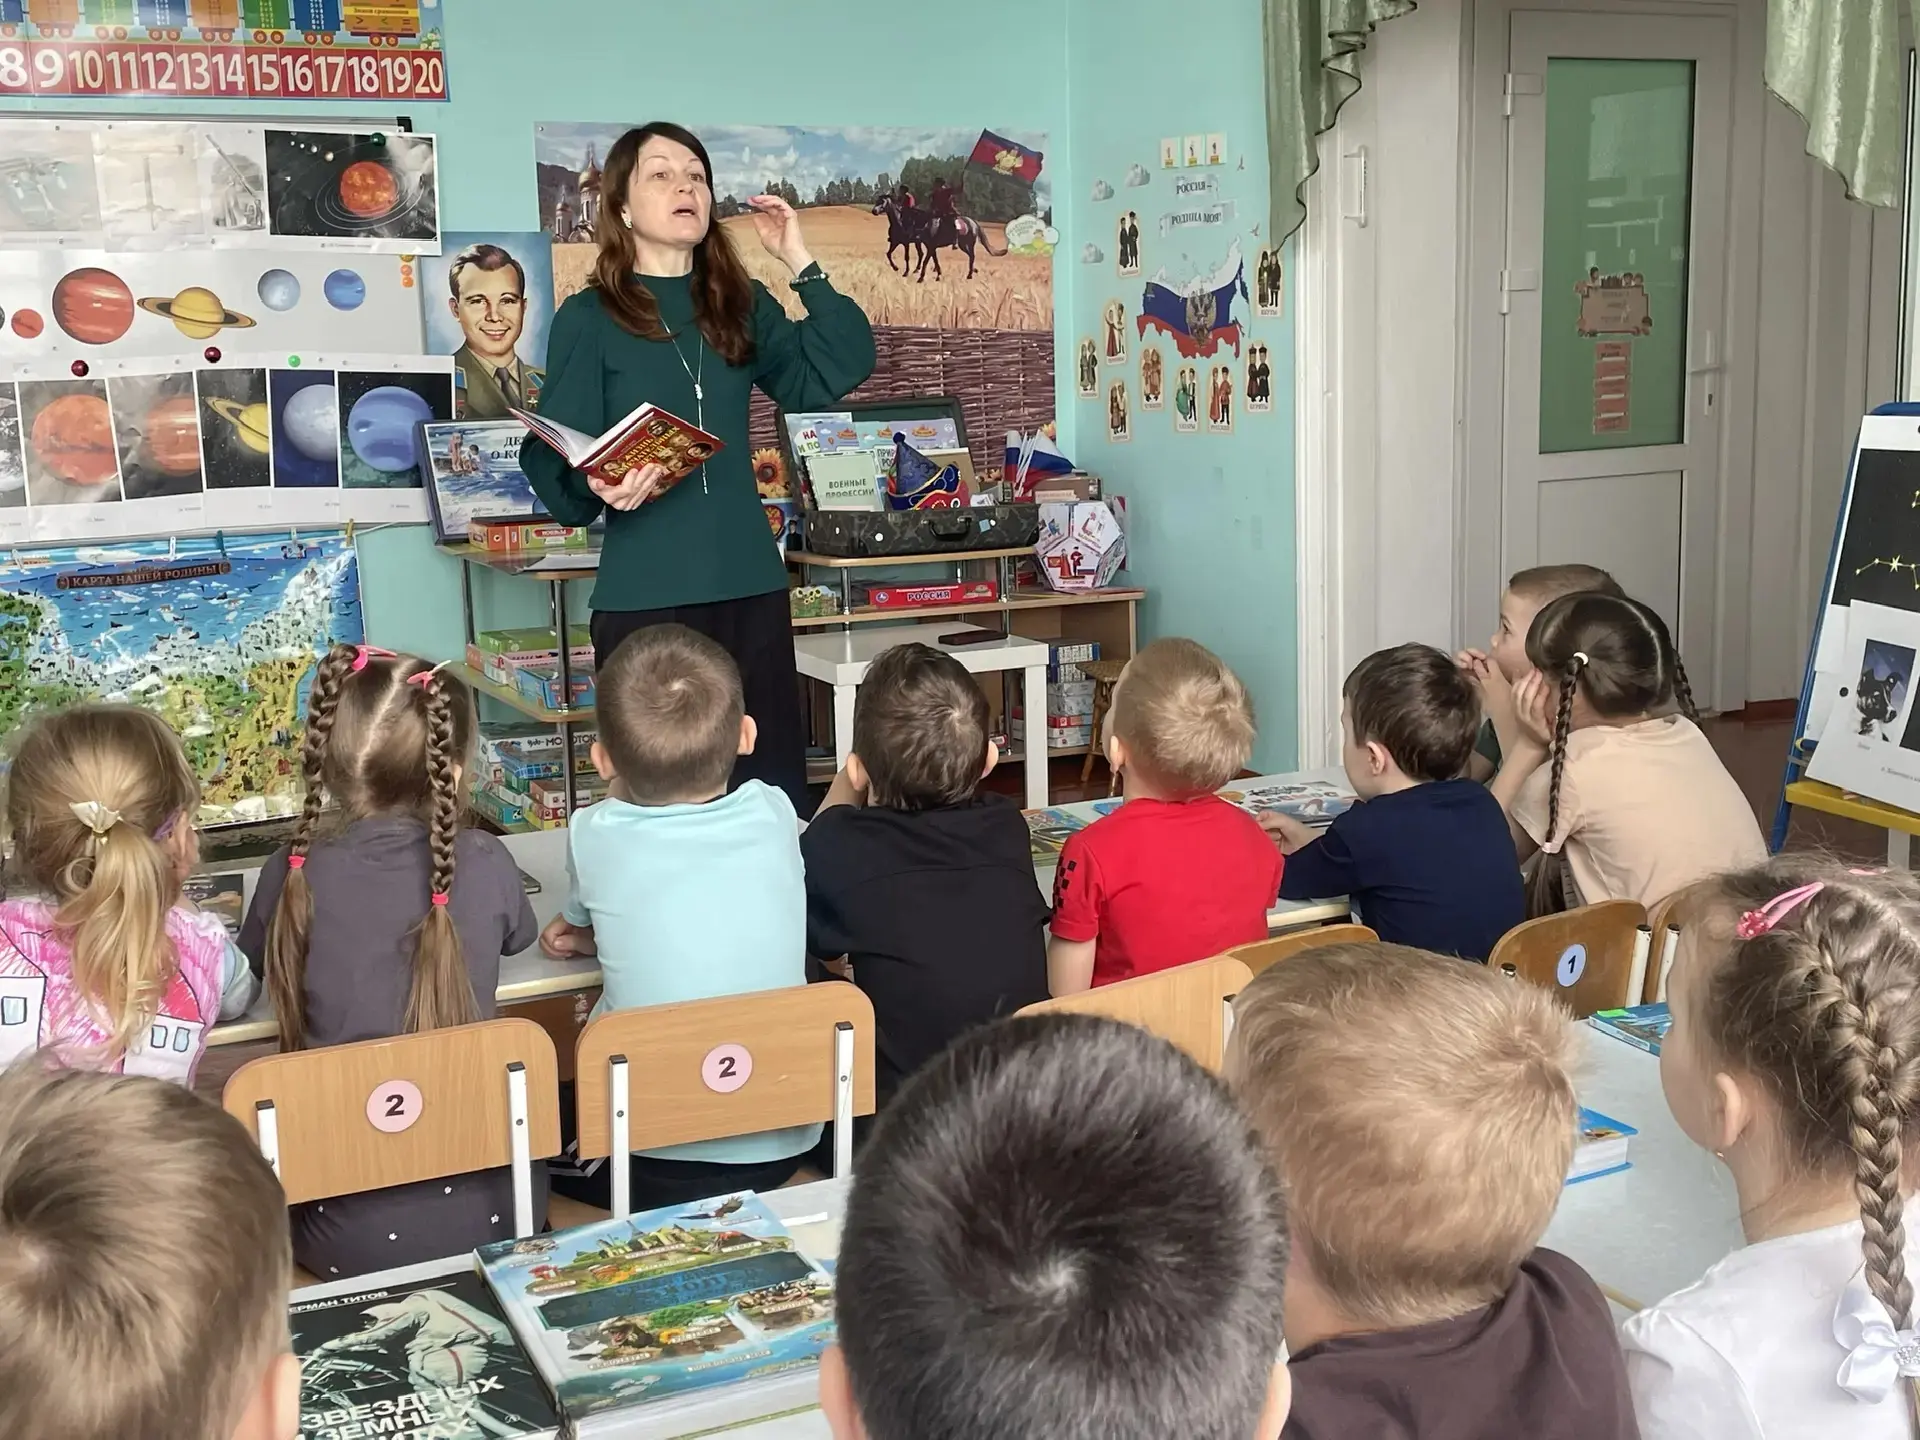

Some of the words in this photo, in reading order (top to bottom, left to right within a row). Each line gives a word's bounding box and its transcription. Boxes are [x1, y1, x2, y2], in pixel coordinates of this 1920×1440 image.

[0, 47, 28, 87] 8
[34, 49, 64, 88] 9
[68, 50, 104, 89] 10
[106, 51, 139, 89] 11
[141, 52, 177, 90] 12
[177, 52, 211, 90] 13
[211, 53, 245, 91] 14
[246, 54, 280, 91] 15
[281, 55, 314, 92] 16
[314, 56, 346, 93] 17
[347, 55, 380, 93] 18
[380, 57, 411, 93] 19
[413, 57, 443, 94] 20
[503, 436, 523, 448] ДЕ
[825, 488, 875, 497] ПРОФЕССИИ
[828, 478, 867, 489] ВОЕННЫЕ
[72, 576, 112, 587] КАРТА
[116, 571, 162, 585] НАШЕЙ
[165, 564, 216, 580] РОДИНЫ
[907, 590, 951, 601] РОССИЯ
[1568, 955, 1577, 974] 1
[718, 1056, 737, 1079] 2
[385, 1094, 405, 1118] 2
[289, 1300, 337, 1313] ЕРМАН
[341, 1291, 388, 1304] ТИТОВ
[301, 1375, 504, 1429] ЗВЕЗДНЫХ
[316, 1400, 475, 1440] ЗЕМНЫХ
